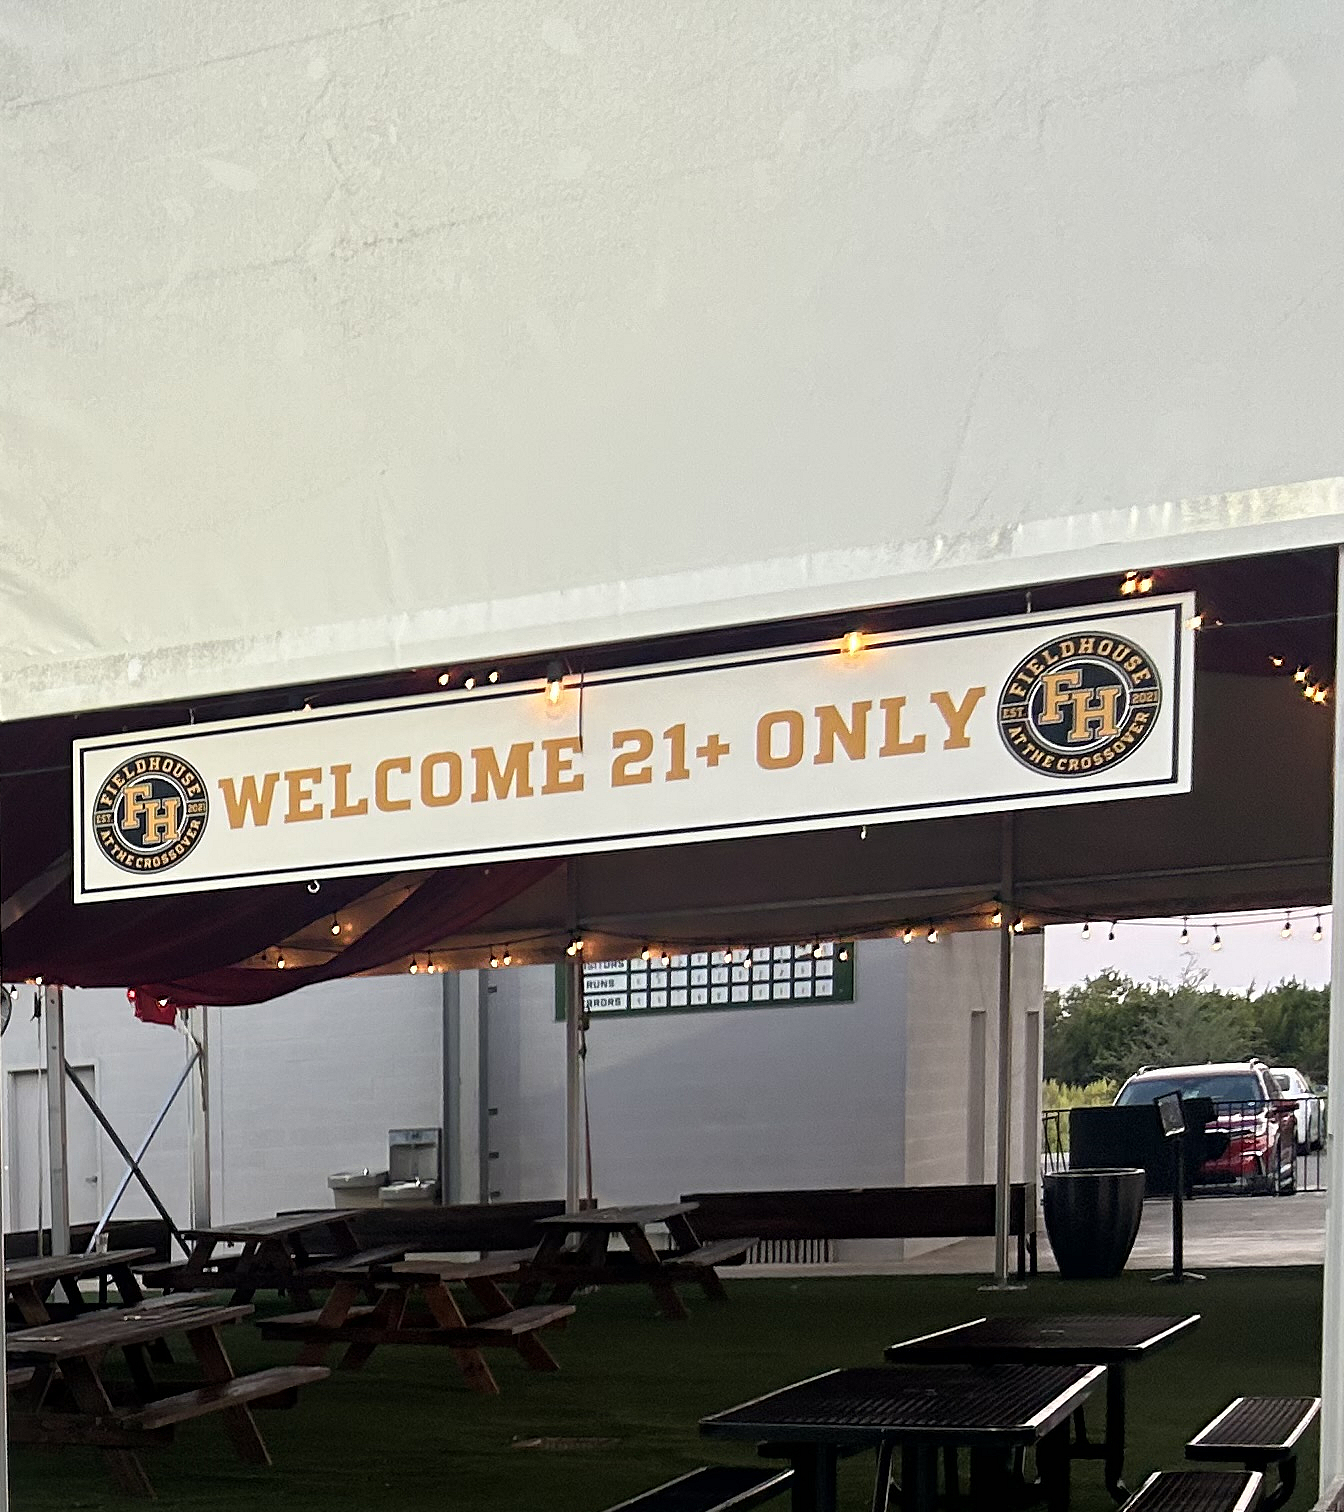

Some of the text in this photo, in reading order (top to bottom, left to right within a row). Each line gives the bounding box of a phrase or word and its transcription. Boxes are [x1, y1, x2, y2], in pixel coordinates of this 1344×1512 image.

[1008, 638, 1151, 698] FIELDHOUSE
[1002, 706, 1027, 719] EST.
[1038, 669, 1122, 743] FH
[1132, 692, 1157, 704] 2021
[218, 687, 986, 830] WELCOME 21+ ONLY
[1008, 711, 1150, 772] AT THE CROSSOVER
[100, 757, 201, 806] FIELDHOUSE
[121, 782, 181, 845] FH
[100, 820, 201, 869] AT THE CROSSOVER
[586, 979, 615, 989] RUNS
[586, 997, 622, 1007] RRORS
